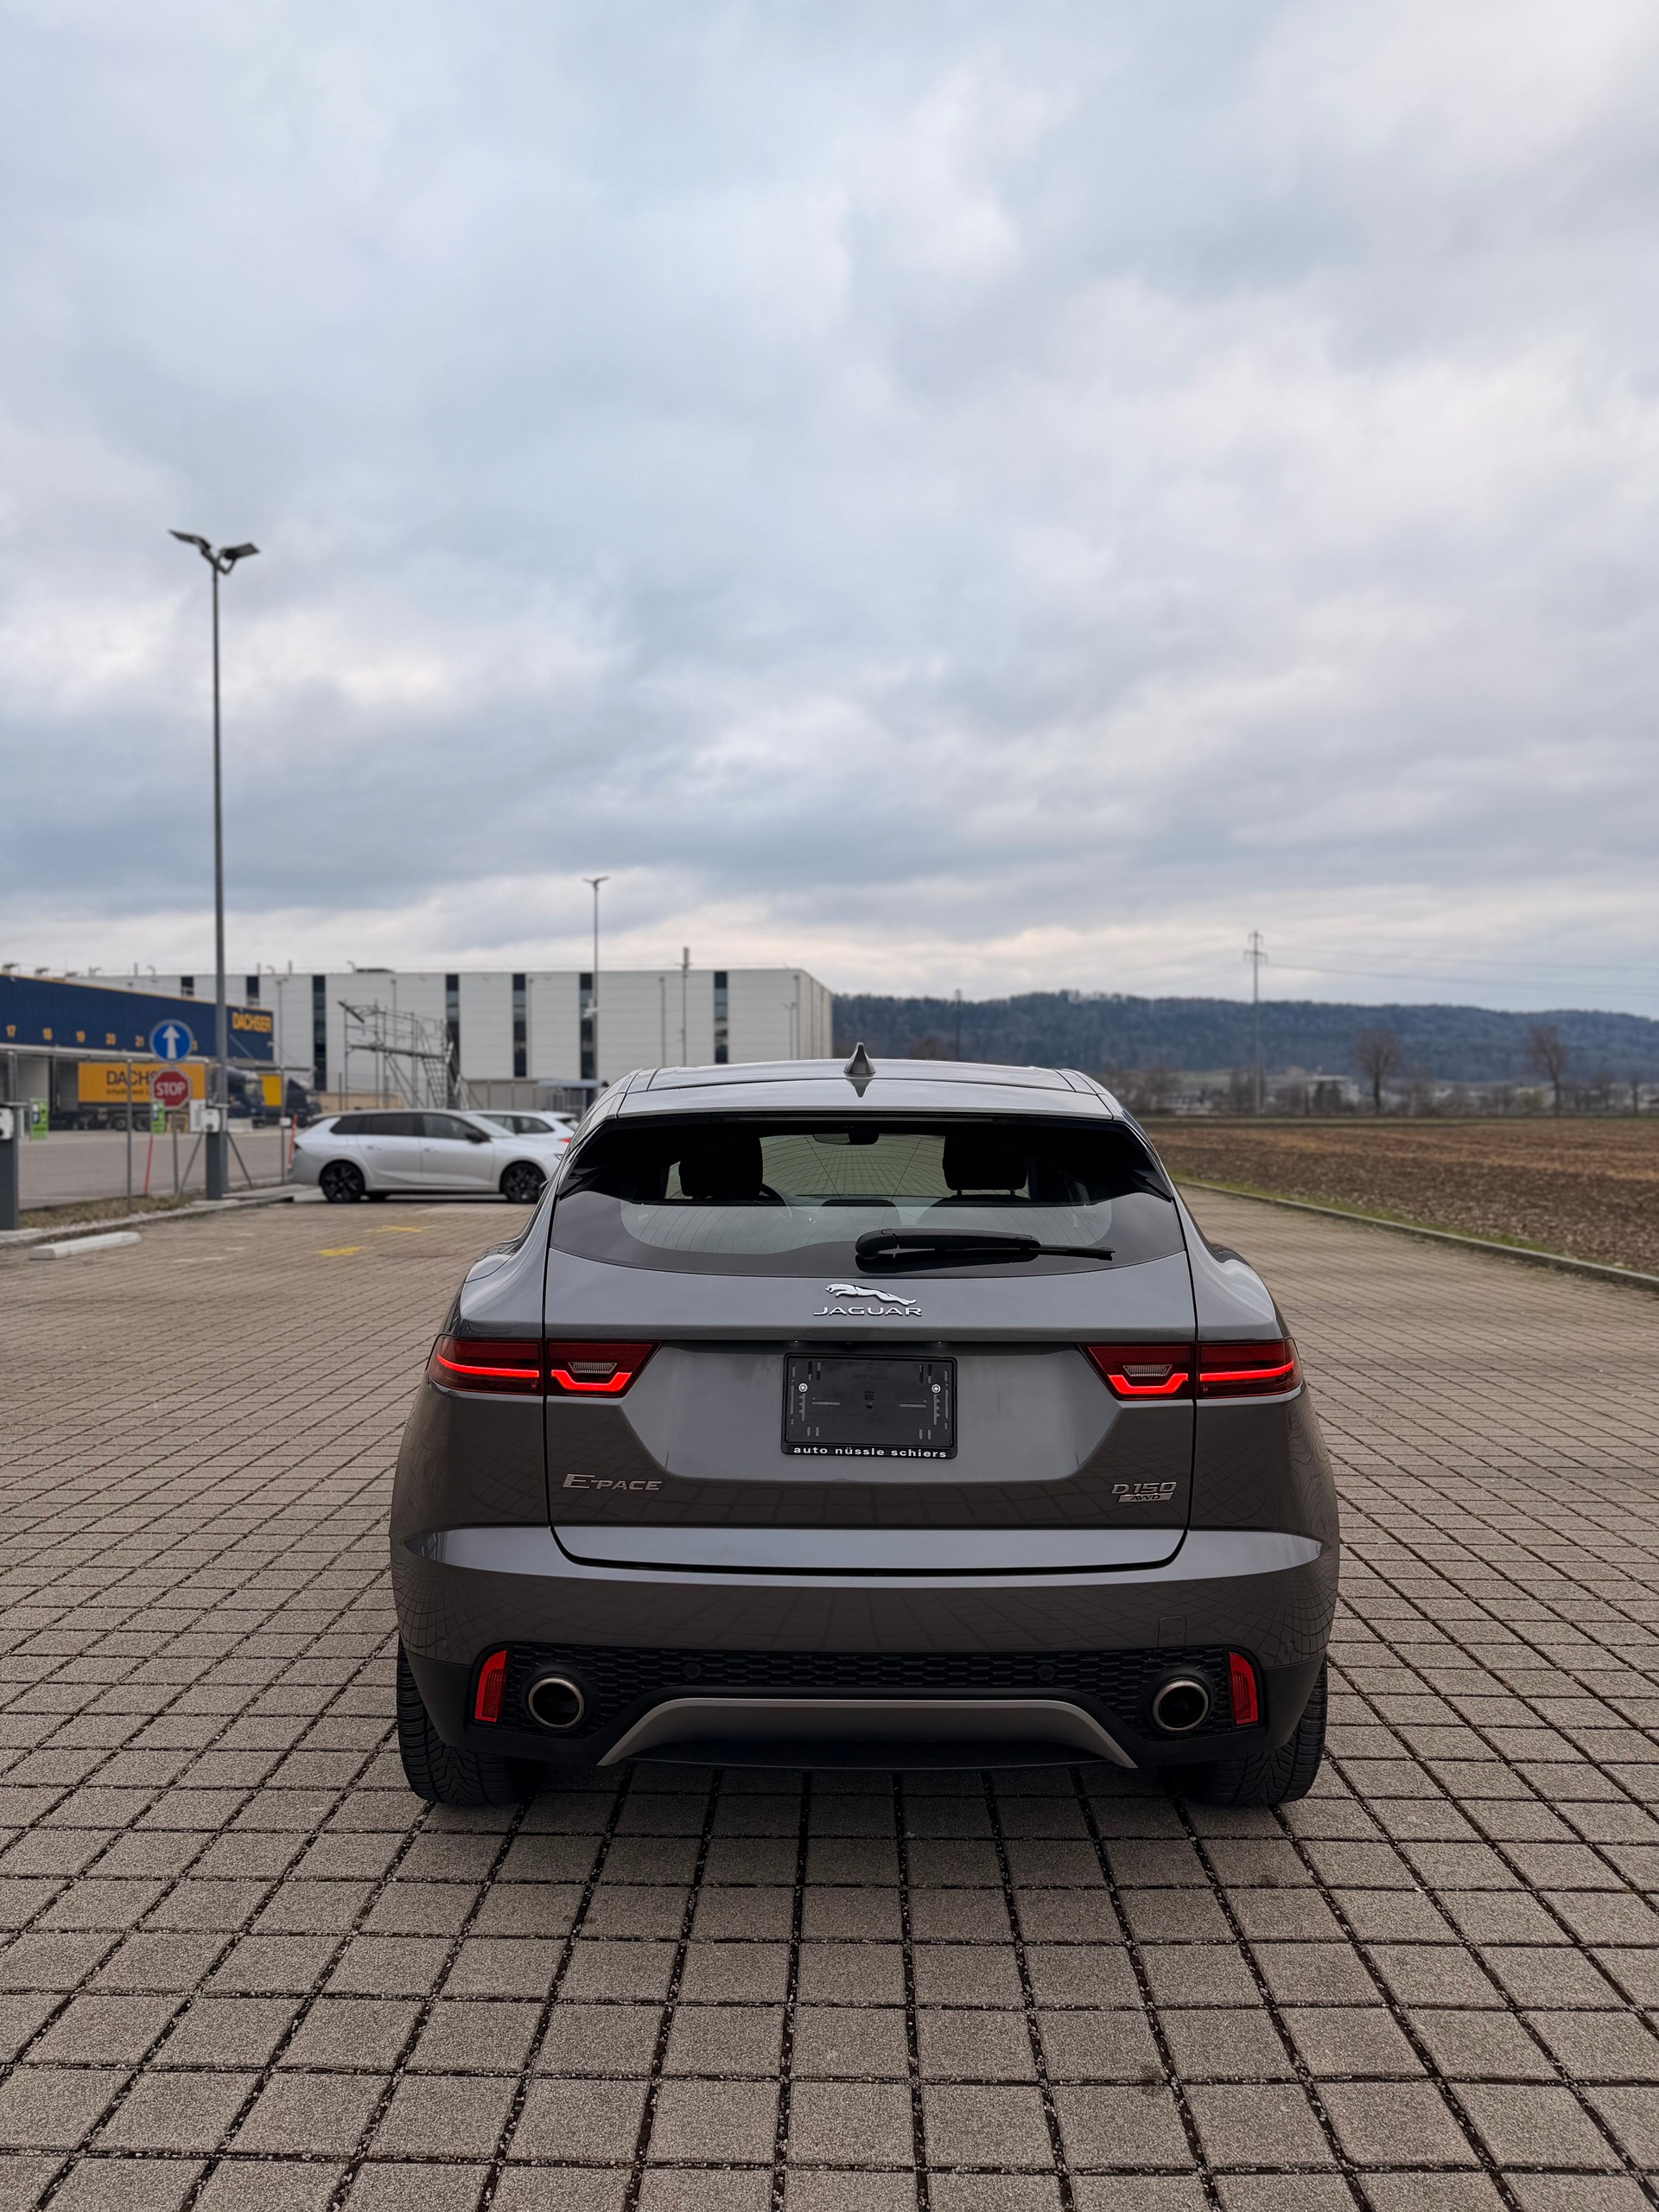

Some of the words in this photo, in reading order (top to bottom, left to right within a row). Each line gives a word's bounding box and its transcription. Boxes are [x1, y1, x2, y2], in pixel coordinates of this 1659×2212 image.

[232, 1012, 272, 1033] DACHSER
[156, 1082, 185, 1096] STOP
[813, 1306, 922, 1316] JAGUAR
[793, 1446, 828, 1455] auto
[835, 1446, 885, 1456] nüssle
[891, 1447, 947, 1458] schiers
